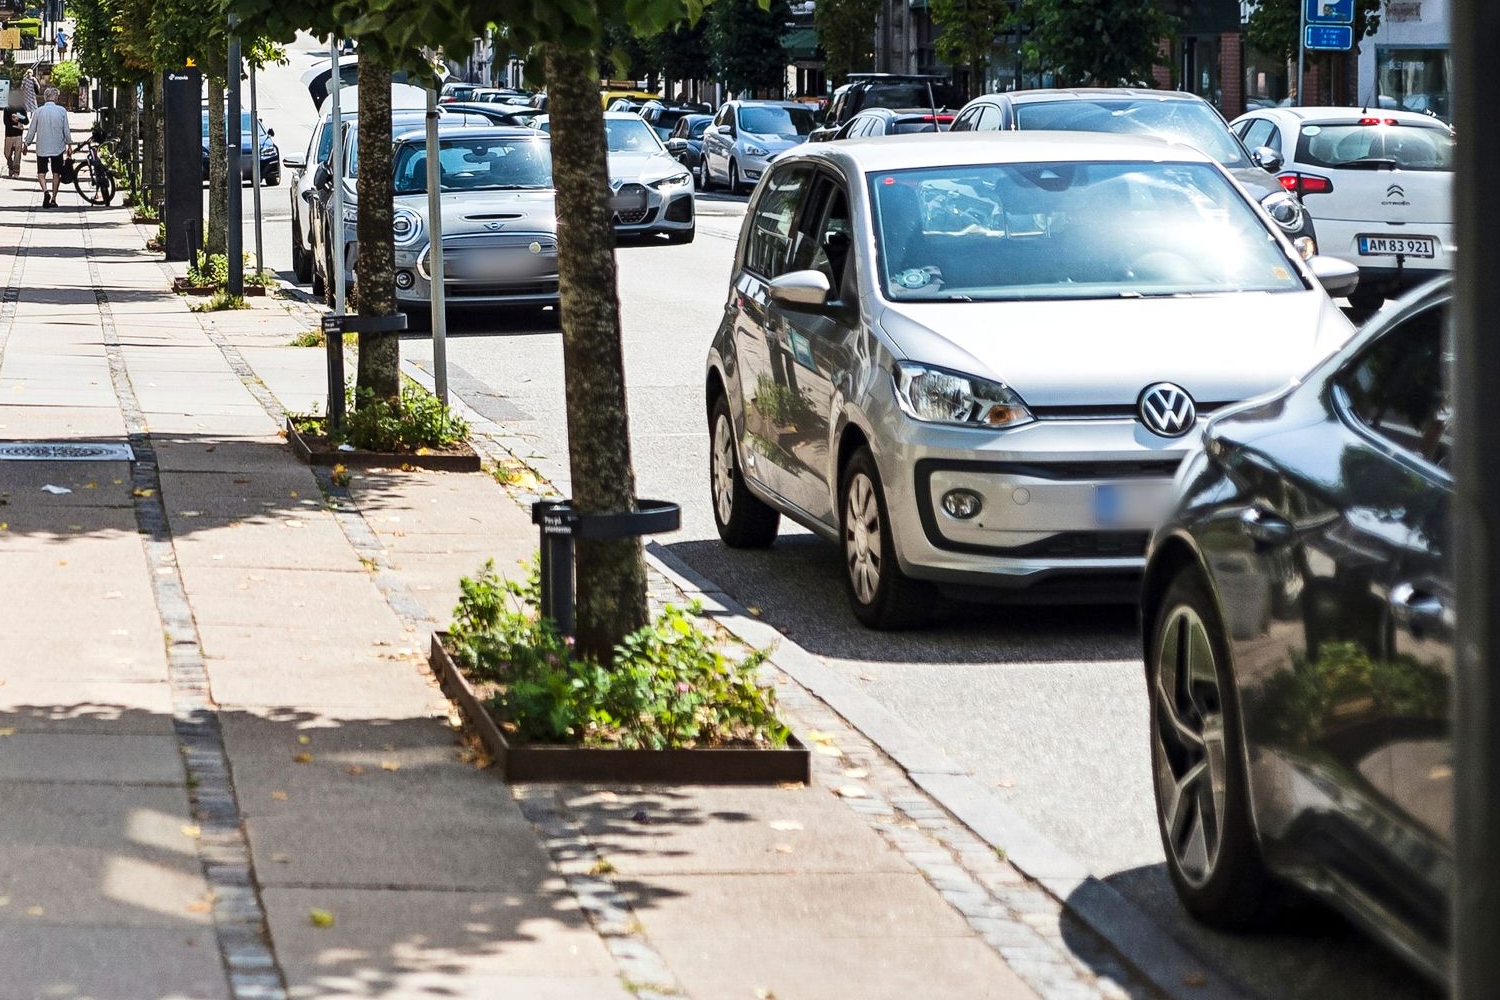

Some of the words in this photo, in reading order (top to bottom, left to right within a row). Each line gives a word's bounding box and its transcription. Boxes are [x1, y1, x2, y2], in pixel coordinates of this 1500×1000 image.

[1369, 239, 1387, 251] AM
[1389, 240, 1405, 252] 83
[1407, 241, 1430, 253] 921
[1142, 385, 1194, 434] VW
